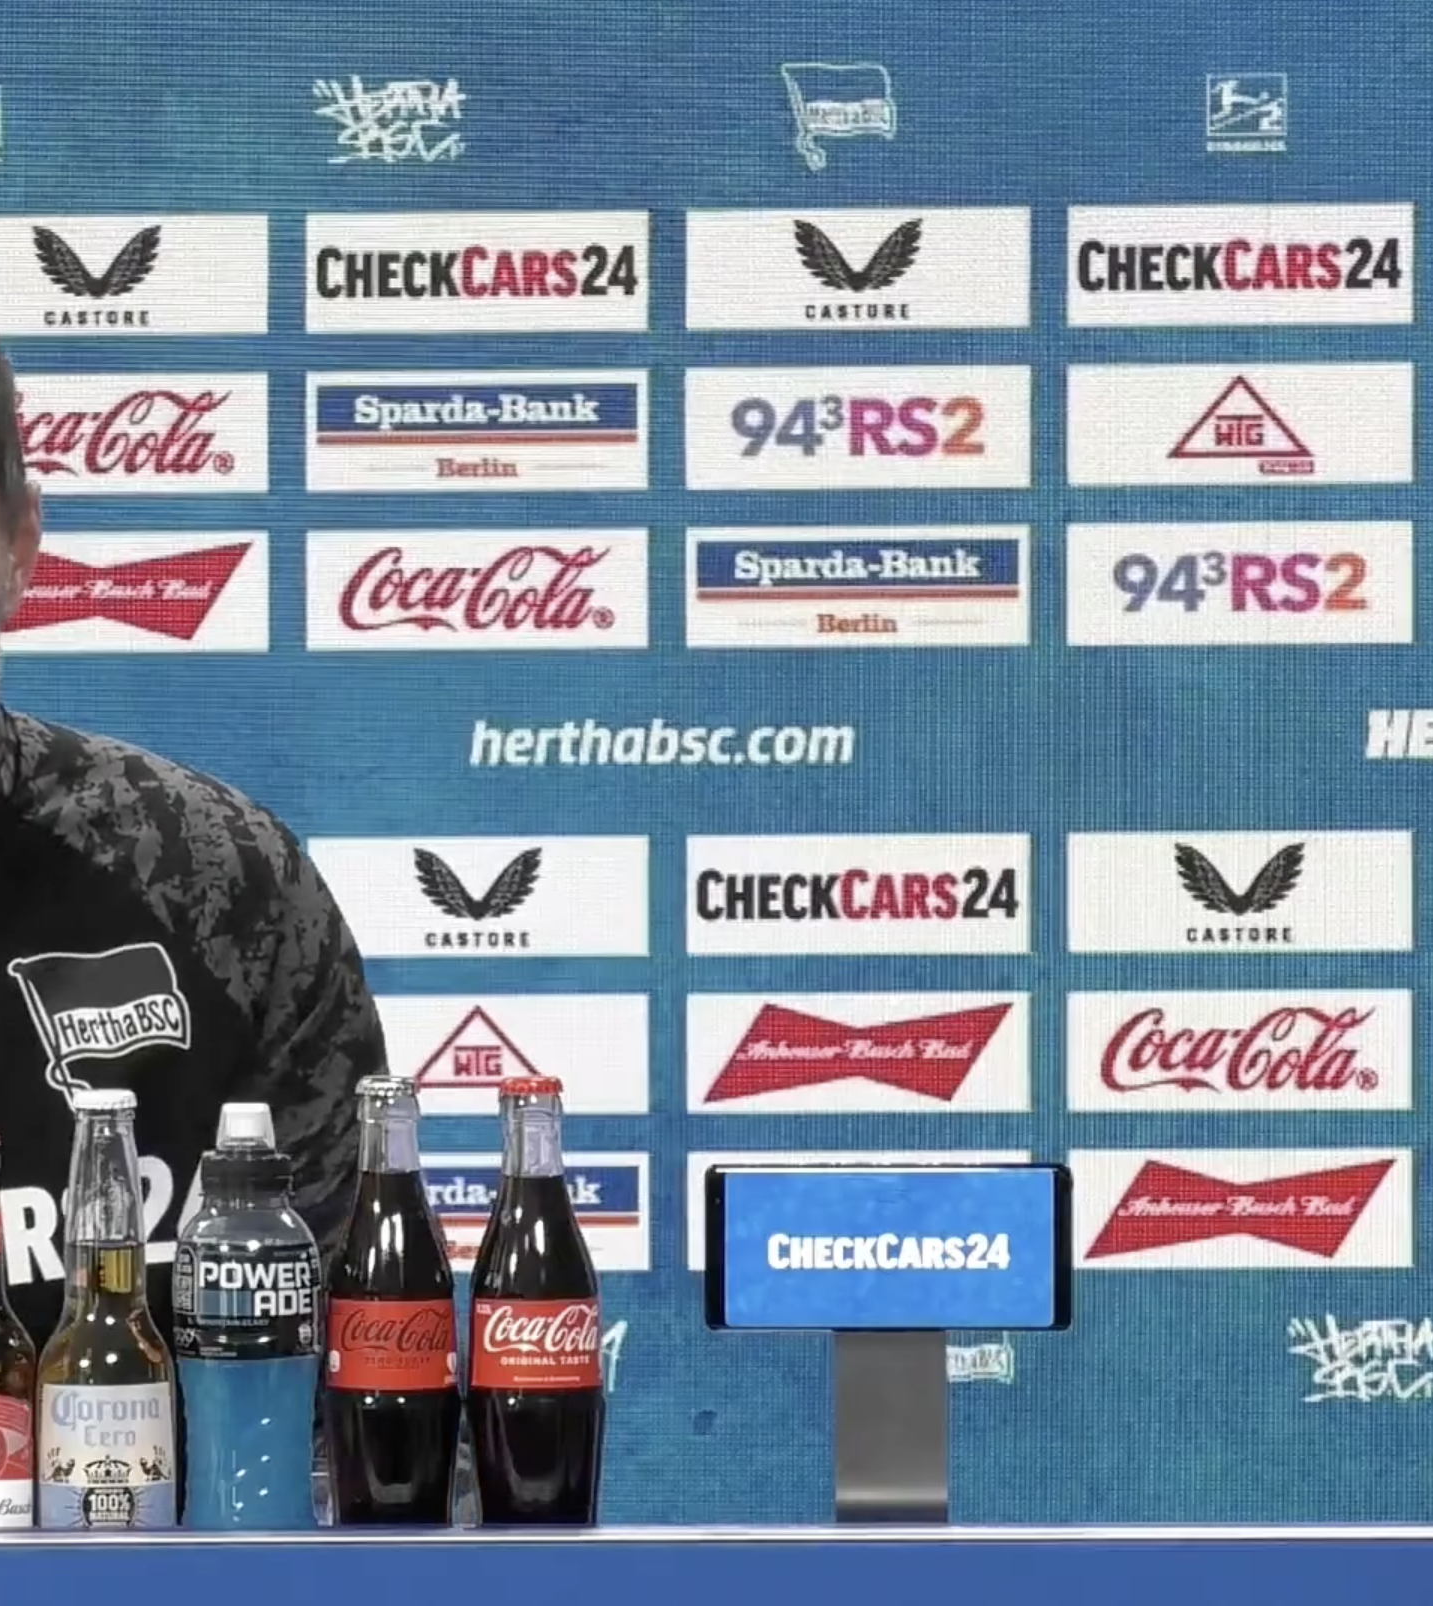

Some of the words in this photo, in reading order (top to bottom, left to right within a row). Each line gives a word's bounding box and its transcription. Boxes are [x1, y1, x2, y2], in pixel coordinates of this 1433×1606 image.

[314, 244, 638, 299] CHECKCARS24
[1077, 237, 1401, 292] CHECKCARS24
[43, 310, 150, 326] CASTORE
[353, 393, 599, 432] Sparda-Bank
[436, 457, 518, 479] Berlin
[733, 548, 982, 586] Sparda-Bank
[816, 613, 898, 634] Berlin
[469, 721, 855, 766] herthabsc.com
[697, 868, 1019, 921] CHECKCARS24
[426, 932, 530, 948] CASTORE
[1187, 927, 1293, 943] CASTORE
[767, 1233, 1012, 1271] CHECKCARS24
[199, 1260, 312, 1290] POWER
[254, 1288, 313, 1318] ADE
[483, 1304, 599, 1353] Coca-Cola
[500, 1355, 557, 1366] ORIGINAL
[560, 1354, 591, 1365] TASTE
[51, 1390, 160, 1431] Corona
[88, 1494, 131, 1511] 100%
